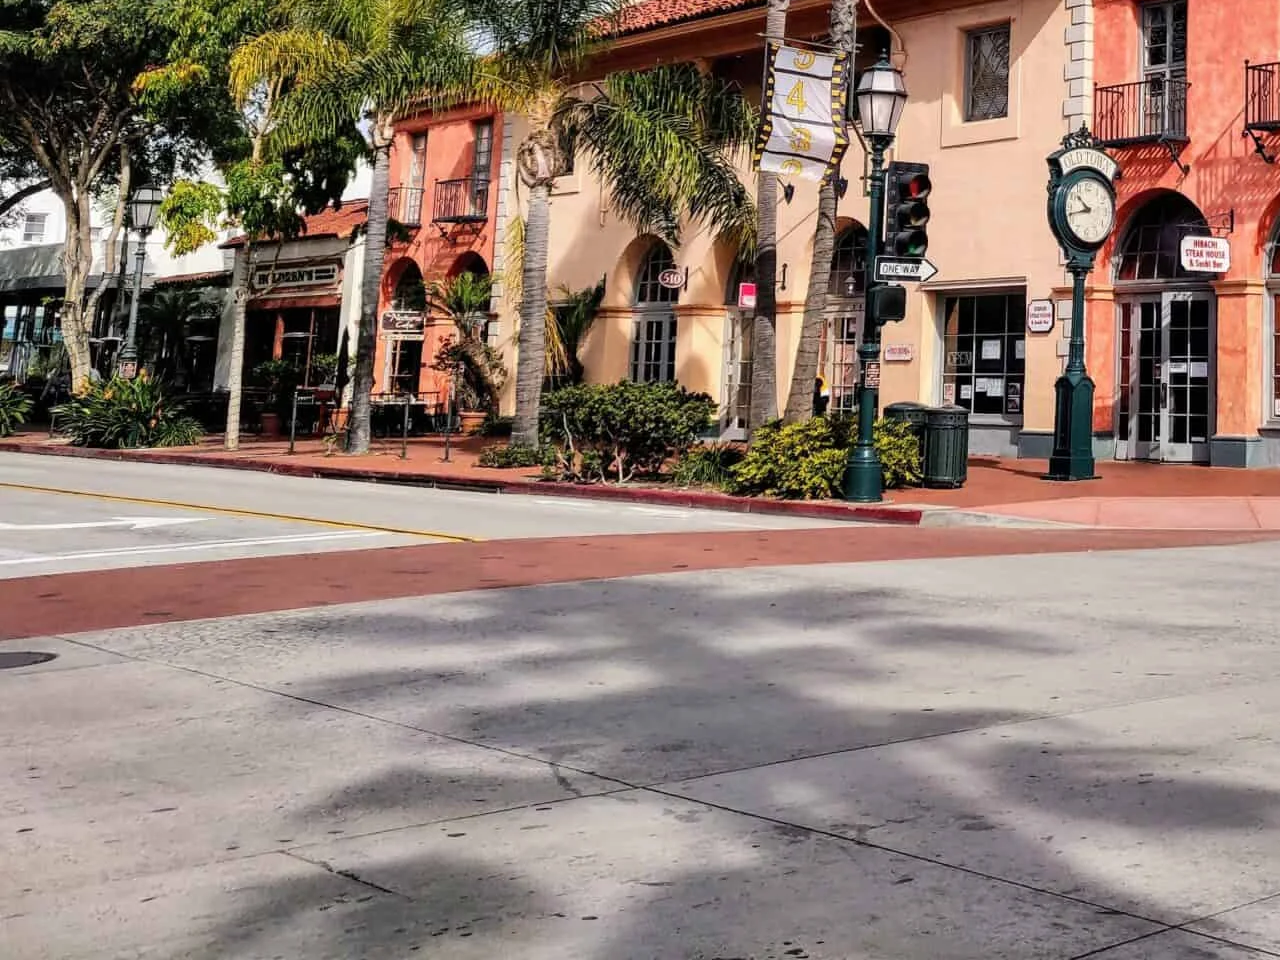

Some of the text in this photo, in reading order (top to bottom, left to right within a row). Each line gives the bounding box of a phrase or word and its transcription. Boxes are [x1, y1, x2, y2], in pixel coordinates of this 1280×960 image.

[785, 78, 808, 113] 4
[1063, 150, 1113, 177] OLD TOWN
[1193, 239, 1218, 248] HIBACHI
[1185, 249, 1225, 258] STEAK HOUSE
[882, 263, 920, 273] ONE WAY
[663, 272, 681, 285] 510
